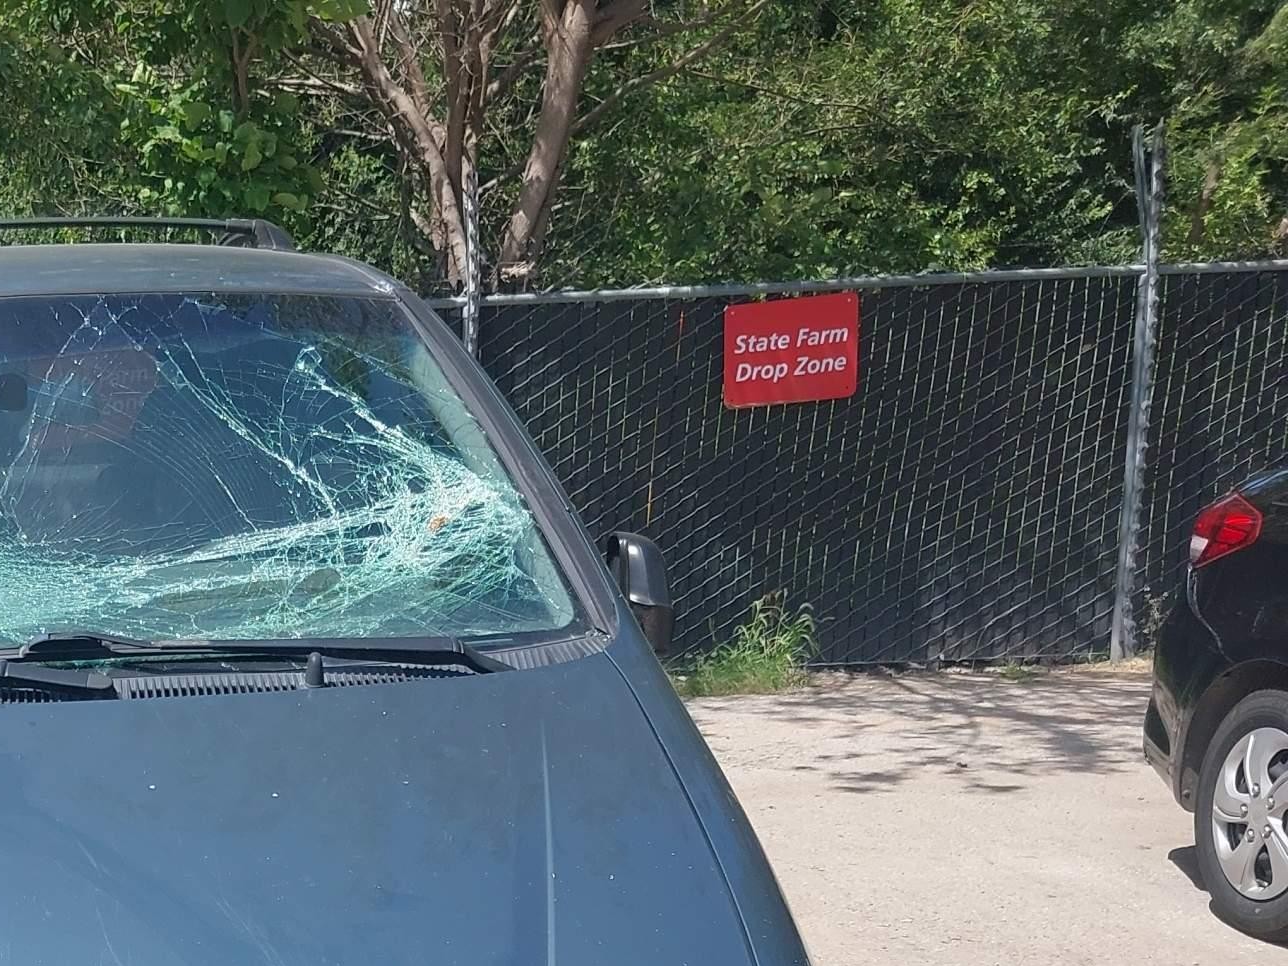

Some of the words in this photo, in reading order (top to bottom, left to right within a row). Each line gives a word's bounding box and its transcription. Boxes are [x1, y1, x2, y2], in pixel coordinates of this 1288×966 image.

[733, 332, 790, 354] State
[796, 327, 849, 347] Farm
[735, 362, 789, 383] Drop
[793, 356, 847, 376] Zone
